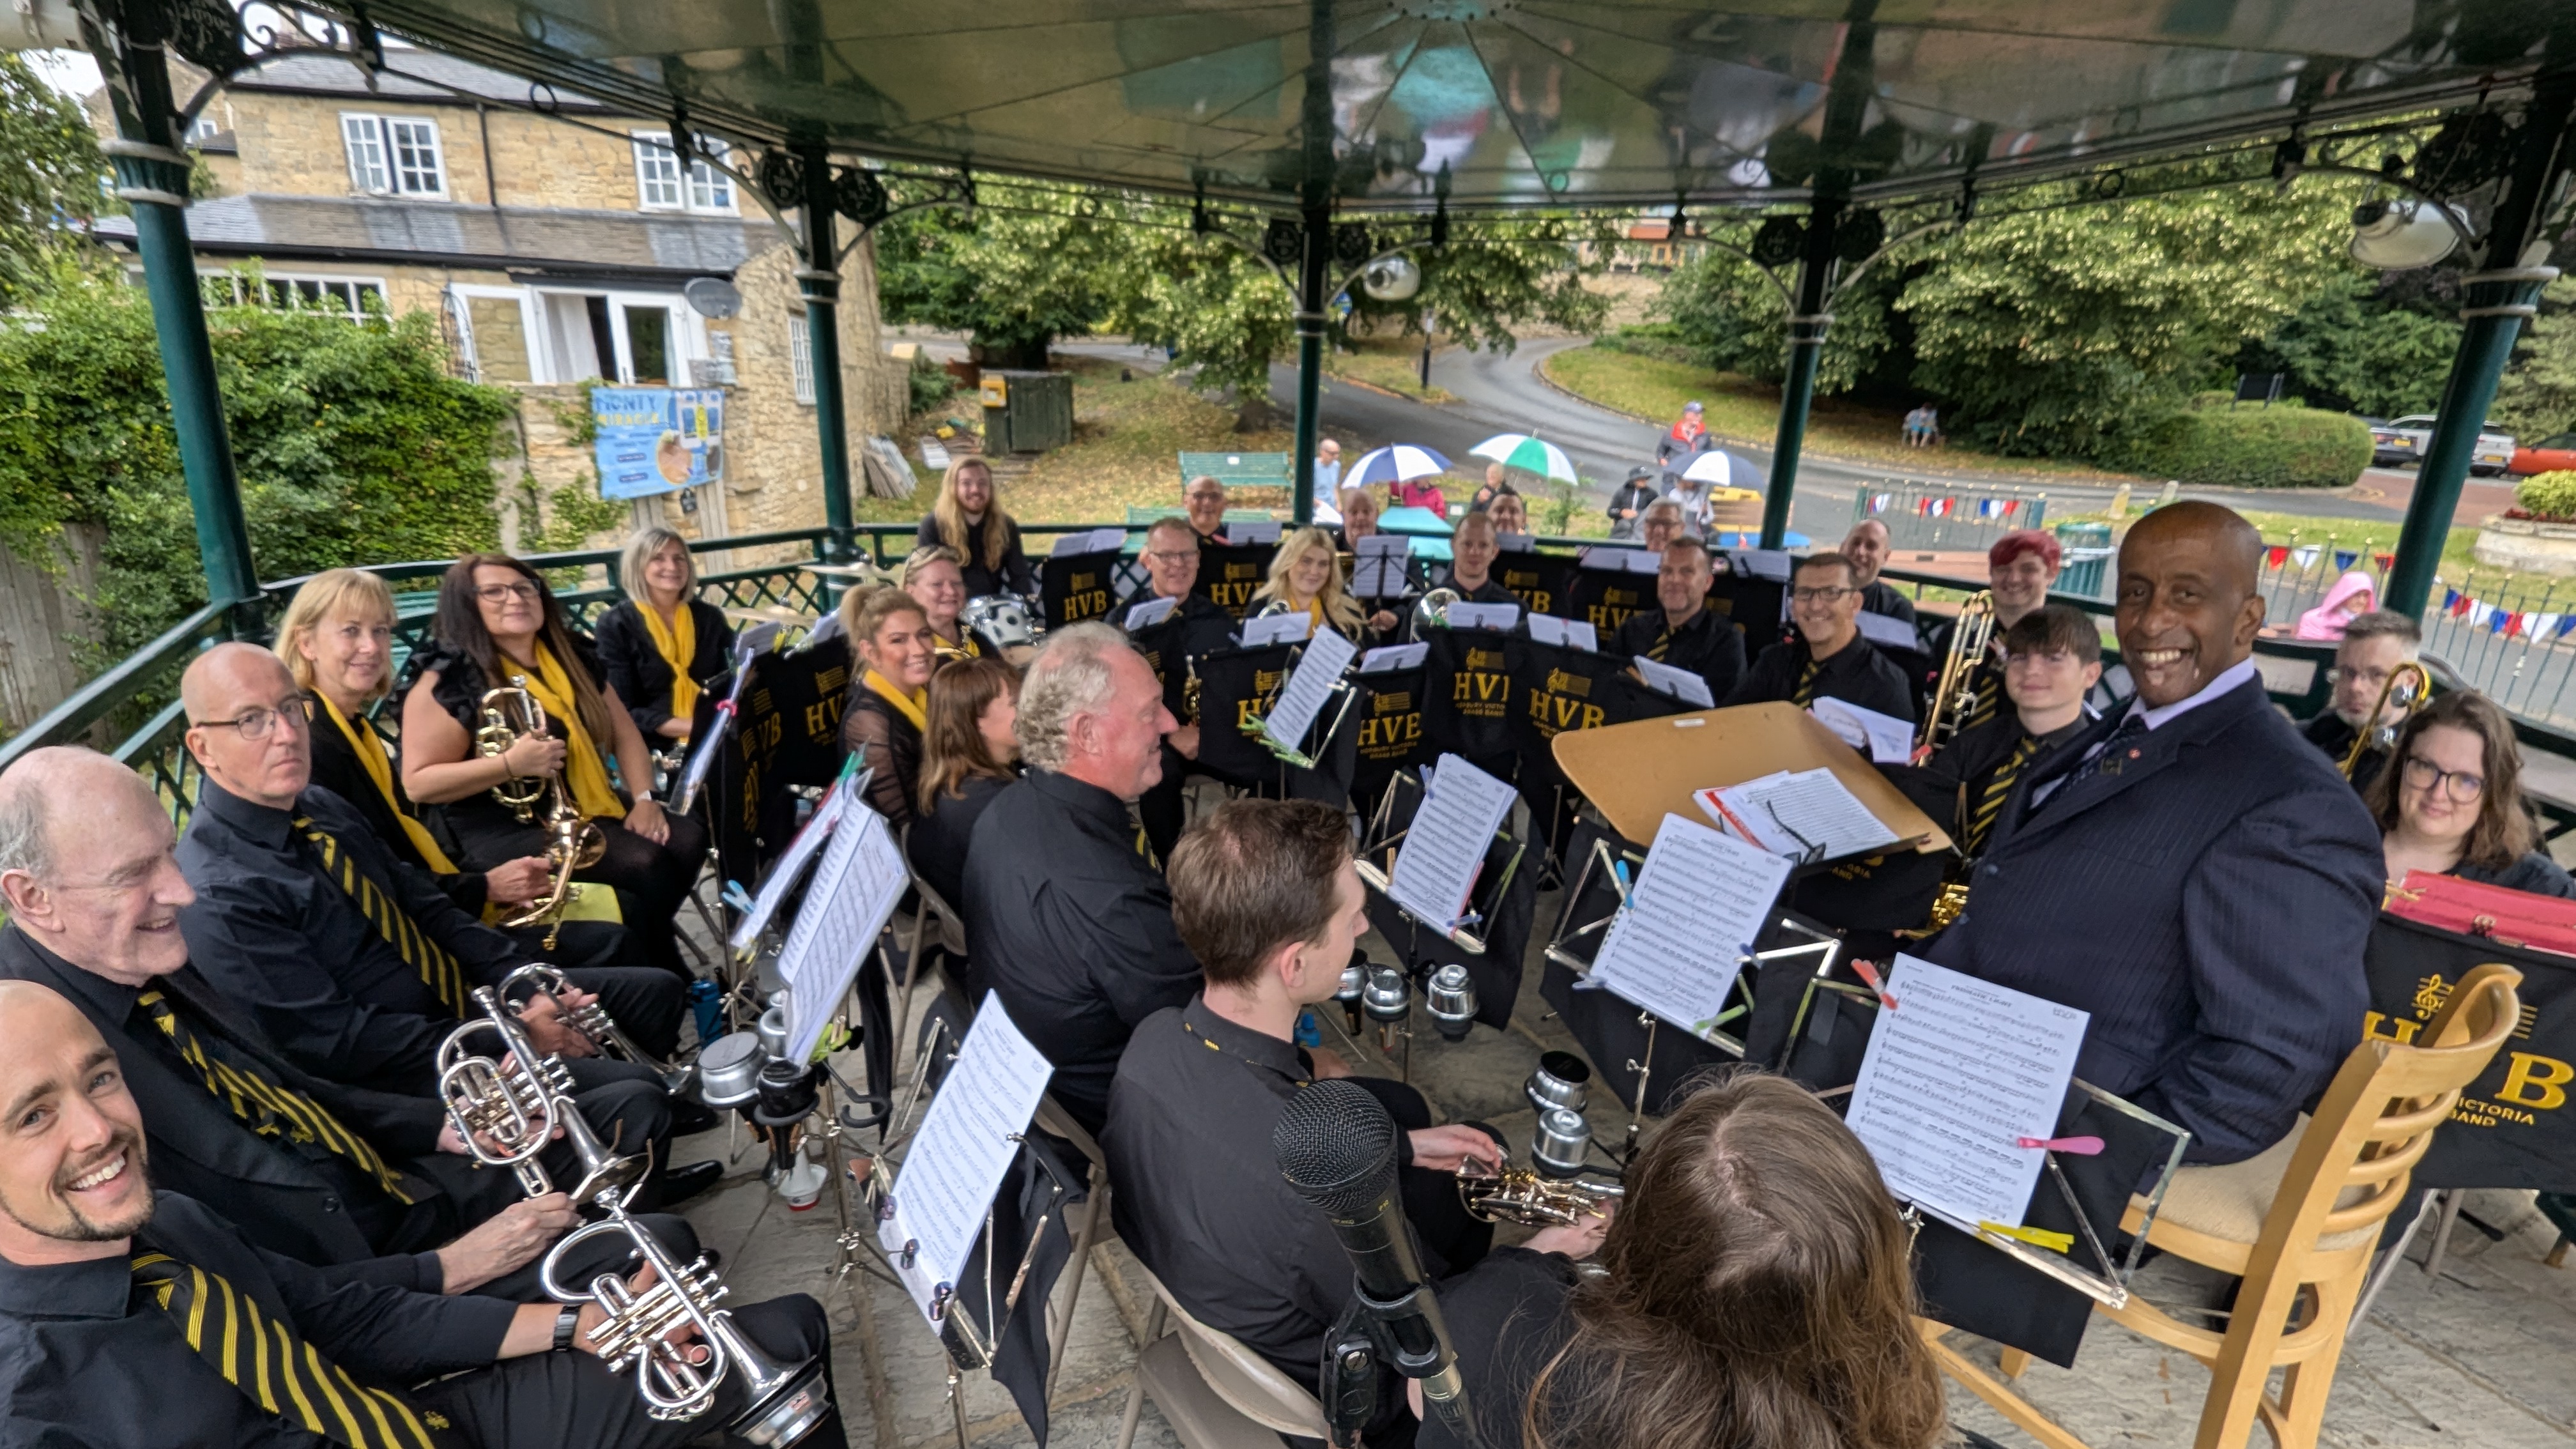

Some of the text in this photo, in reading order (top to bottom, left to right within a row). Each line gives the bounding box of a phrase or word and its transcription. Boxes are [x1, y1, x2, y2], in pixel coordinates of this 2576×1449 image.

[1064, 590, 1107, 621] HVB
[1210, 582, 1265, 605] HV
[1588, 604, 1646, 629] HV
[806, 693, 844, 736] HV
[2363, 1010, 2575, 1110] HB
[2458, 1096, 2535, 1126] ICTORIA
